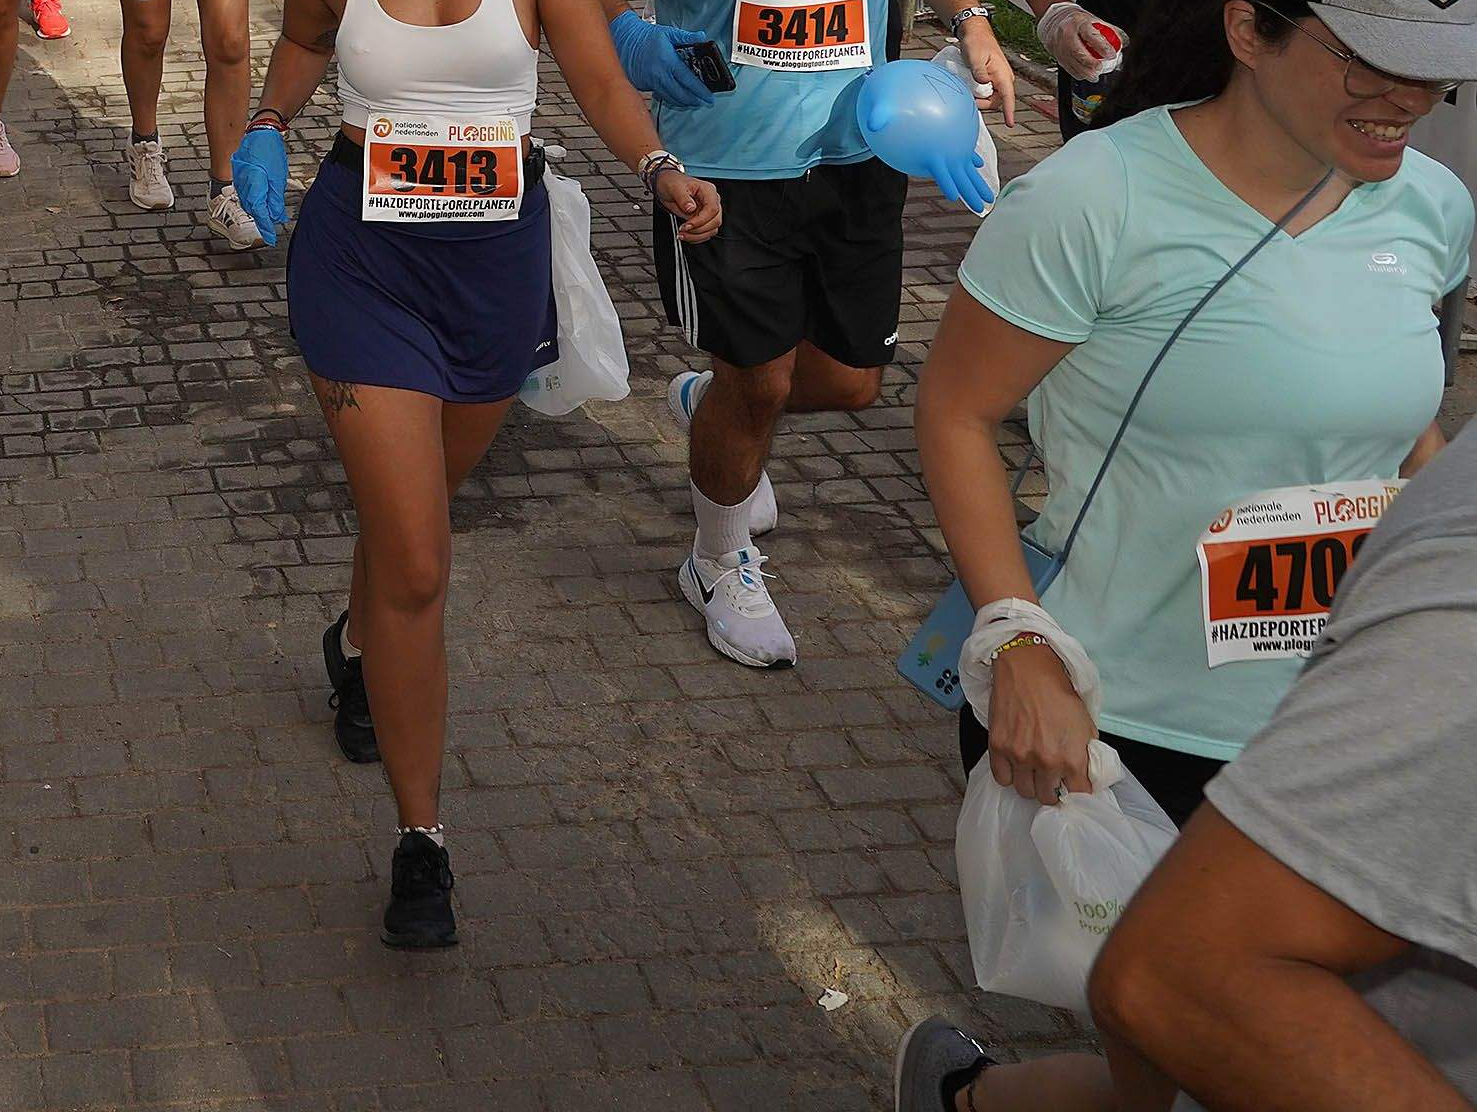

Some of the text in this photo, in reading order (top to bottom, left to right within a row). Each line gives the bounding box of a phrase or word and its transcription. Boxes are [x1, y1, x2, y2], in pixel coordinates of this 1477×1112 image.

[757, 3, 849, 46] 3414
[737, 45, 866, 61] #HAZDEPORTEPORELPLANETA
[395, 121, 428, 130] nationale
[395, 129, 439, 137] nederlanden
[448, 125, 515, 142] PLOGGING
[390, 147, 498, 194] 3413
[368, 197, 516, 211] #HAZDEPORTEPORELPLANETA
[1236, 501, 1283, 516] nationale
[1235, 512, 1302, 526] nederlanden
[1235, 531, 1369, 612] 470
